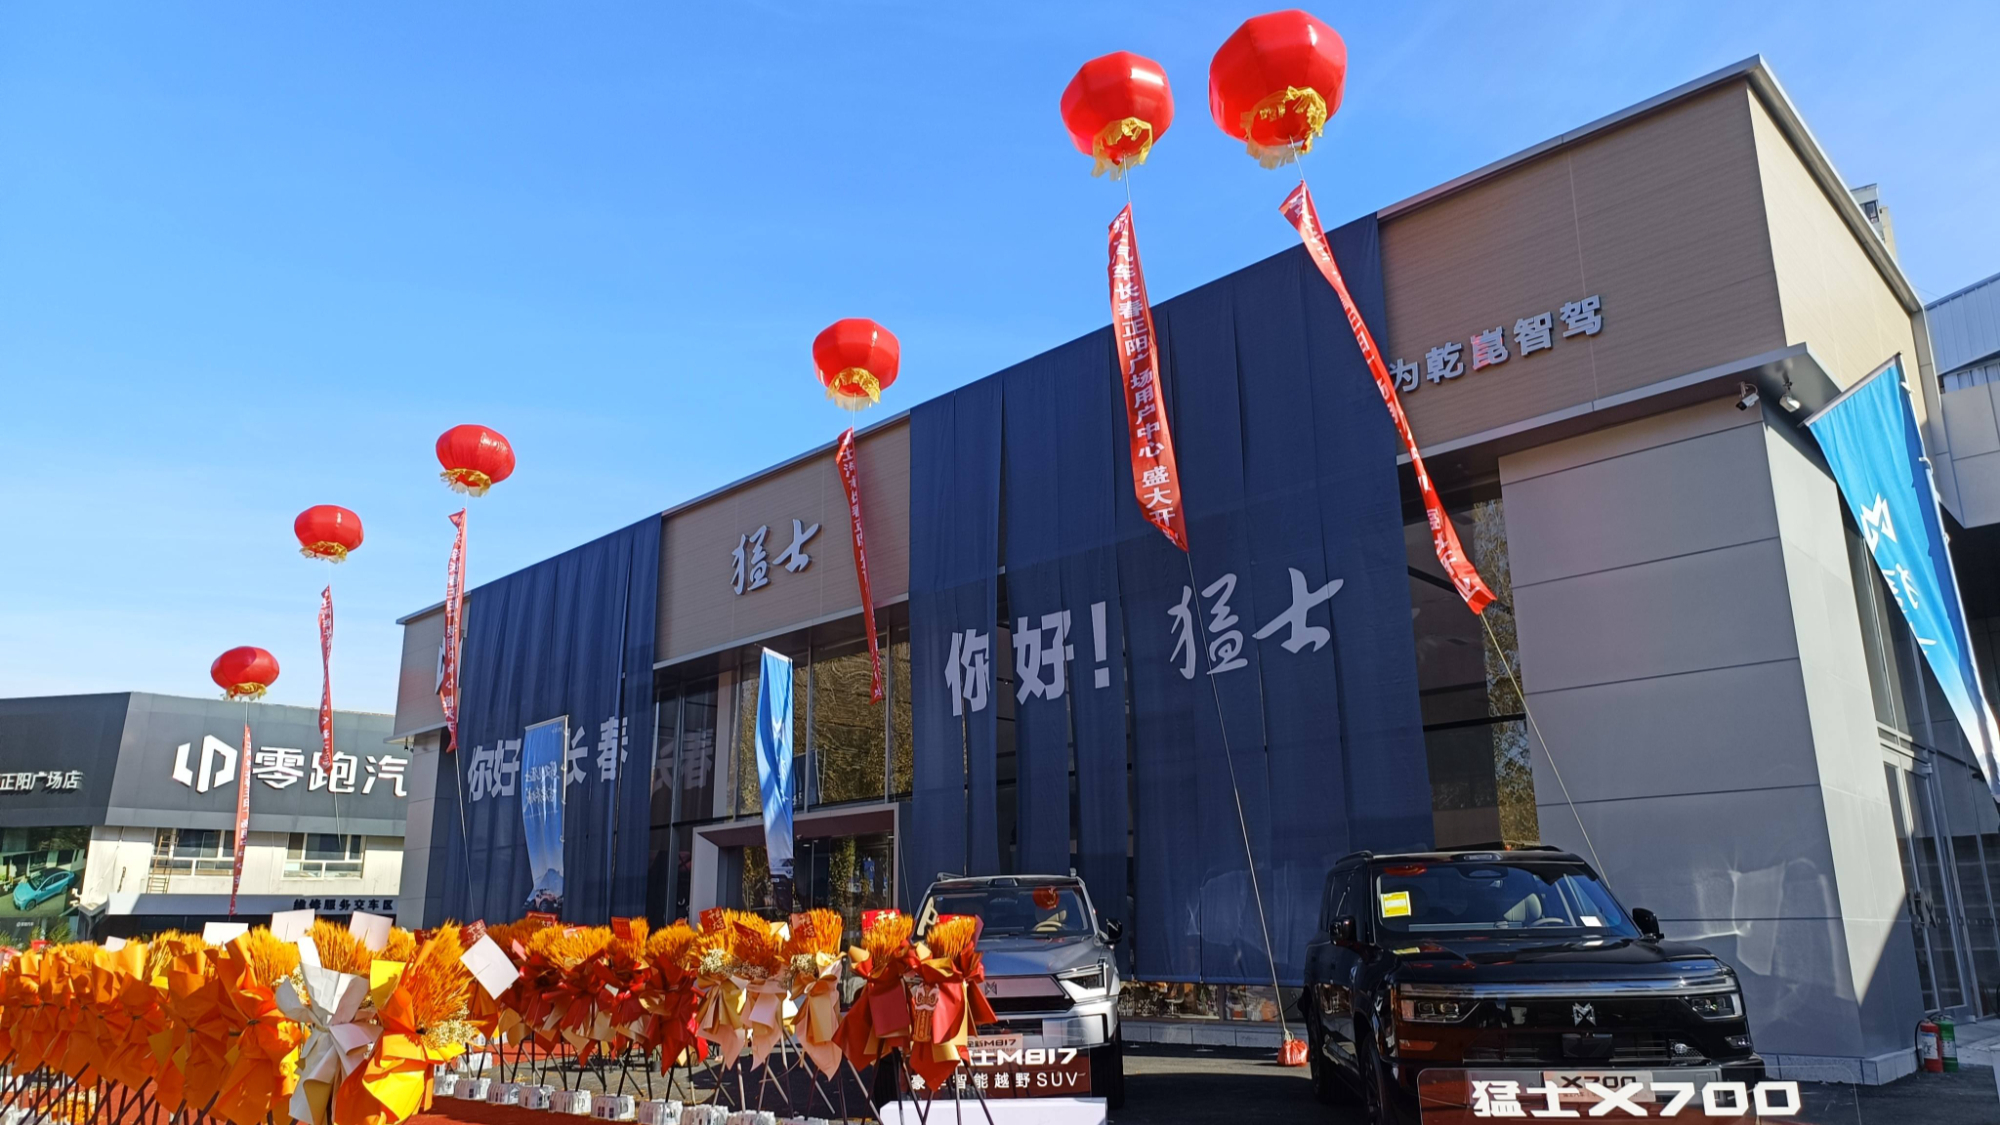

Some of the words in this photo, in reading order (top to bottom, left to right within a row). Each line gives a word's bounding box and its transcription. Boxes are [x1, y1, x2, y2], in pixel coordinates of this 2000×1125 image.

[730, 518, 822, 595] 猛士
[1168, 567, 1344, 680] 猛士
[252, 746, 408, 797] 零跑汽
[467, 738, 522, 803] 你好
[959, 1048, 1077, 1067] 士M817
[1472, 1080, 1801, 1117] 猛士X700
